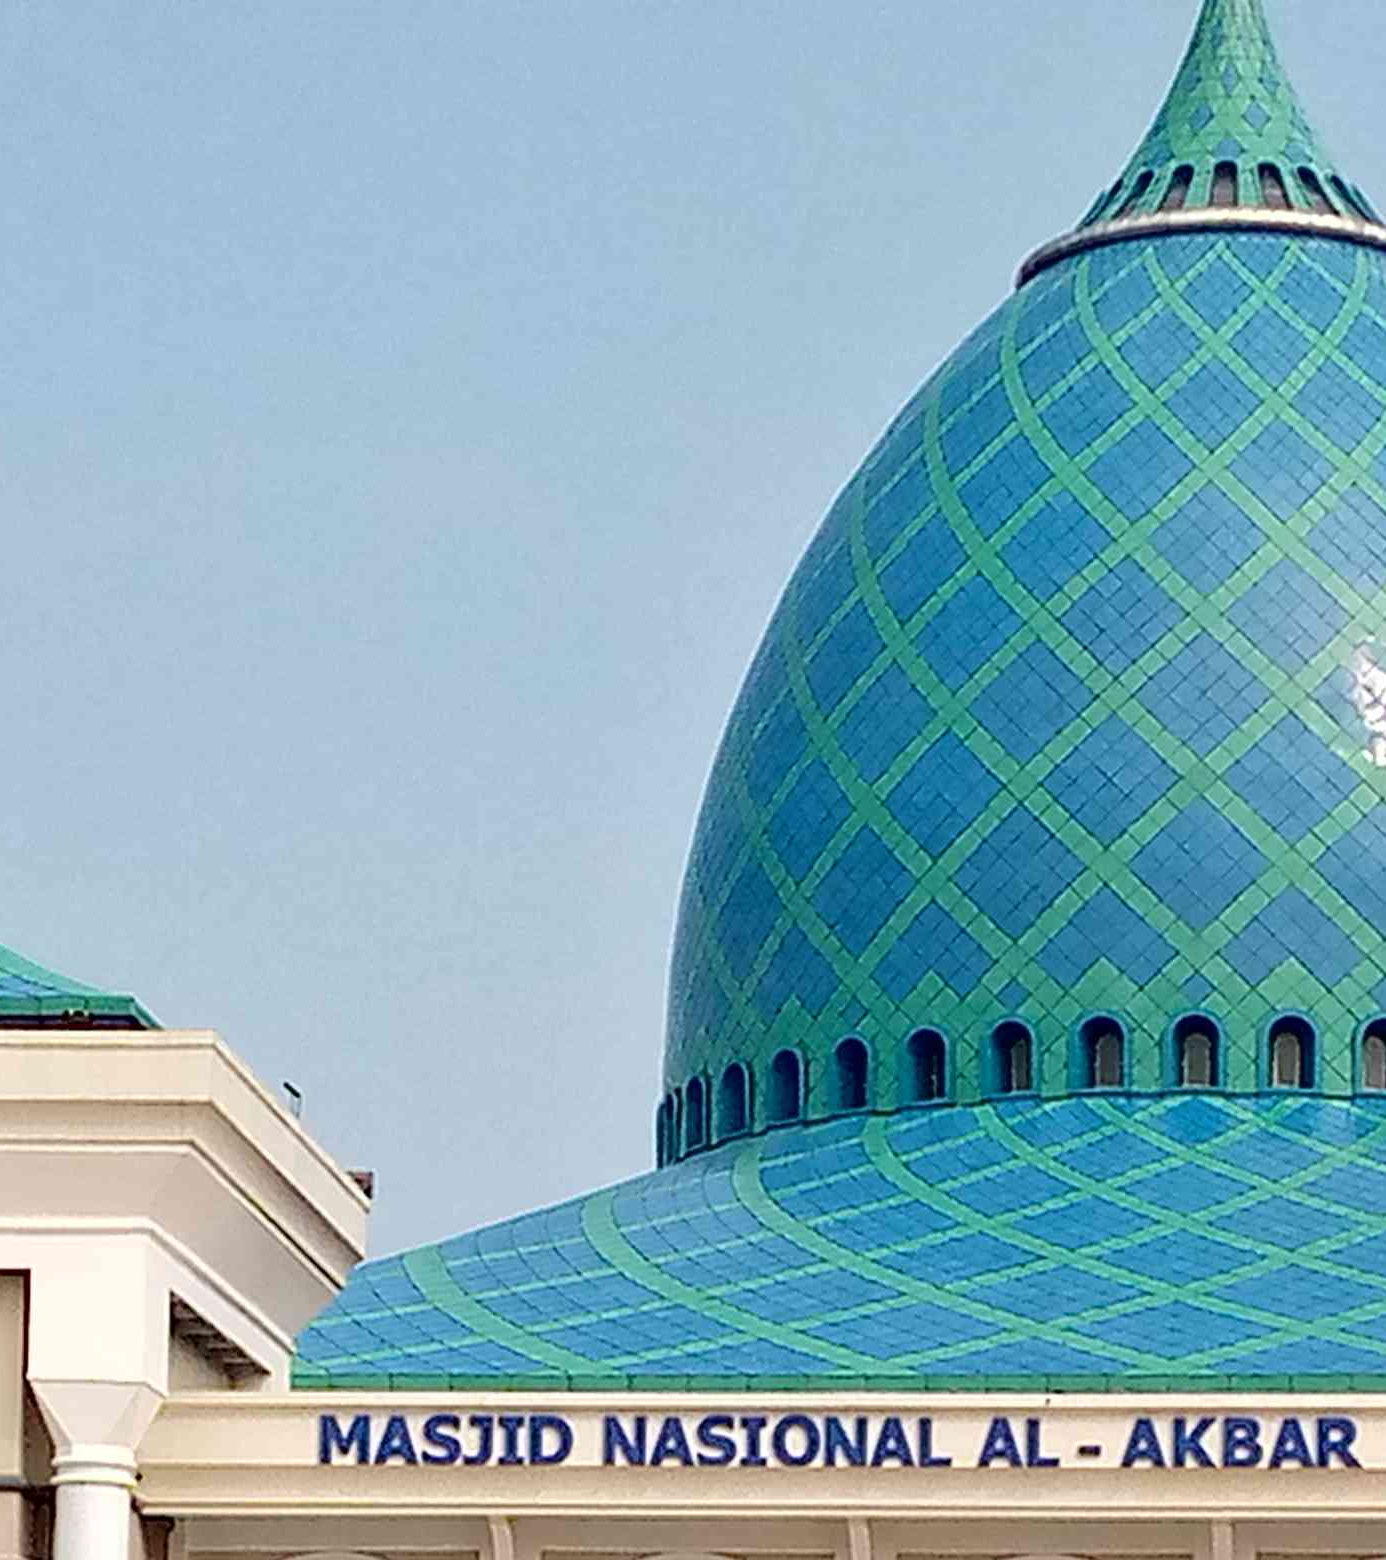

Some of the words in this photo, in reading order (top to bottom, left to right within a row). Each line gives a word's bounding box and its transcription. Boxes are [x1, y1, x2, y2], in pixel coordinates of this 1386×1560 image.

[318, 1414, 573, 1466] MASJID
[603, 1415, 953, 1467] NASIONAL
[978, 1417, 1060, 1468] AL
[1120, 1417, 1363, 1469] AKBAR
